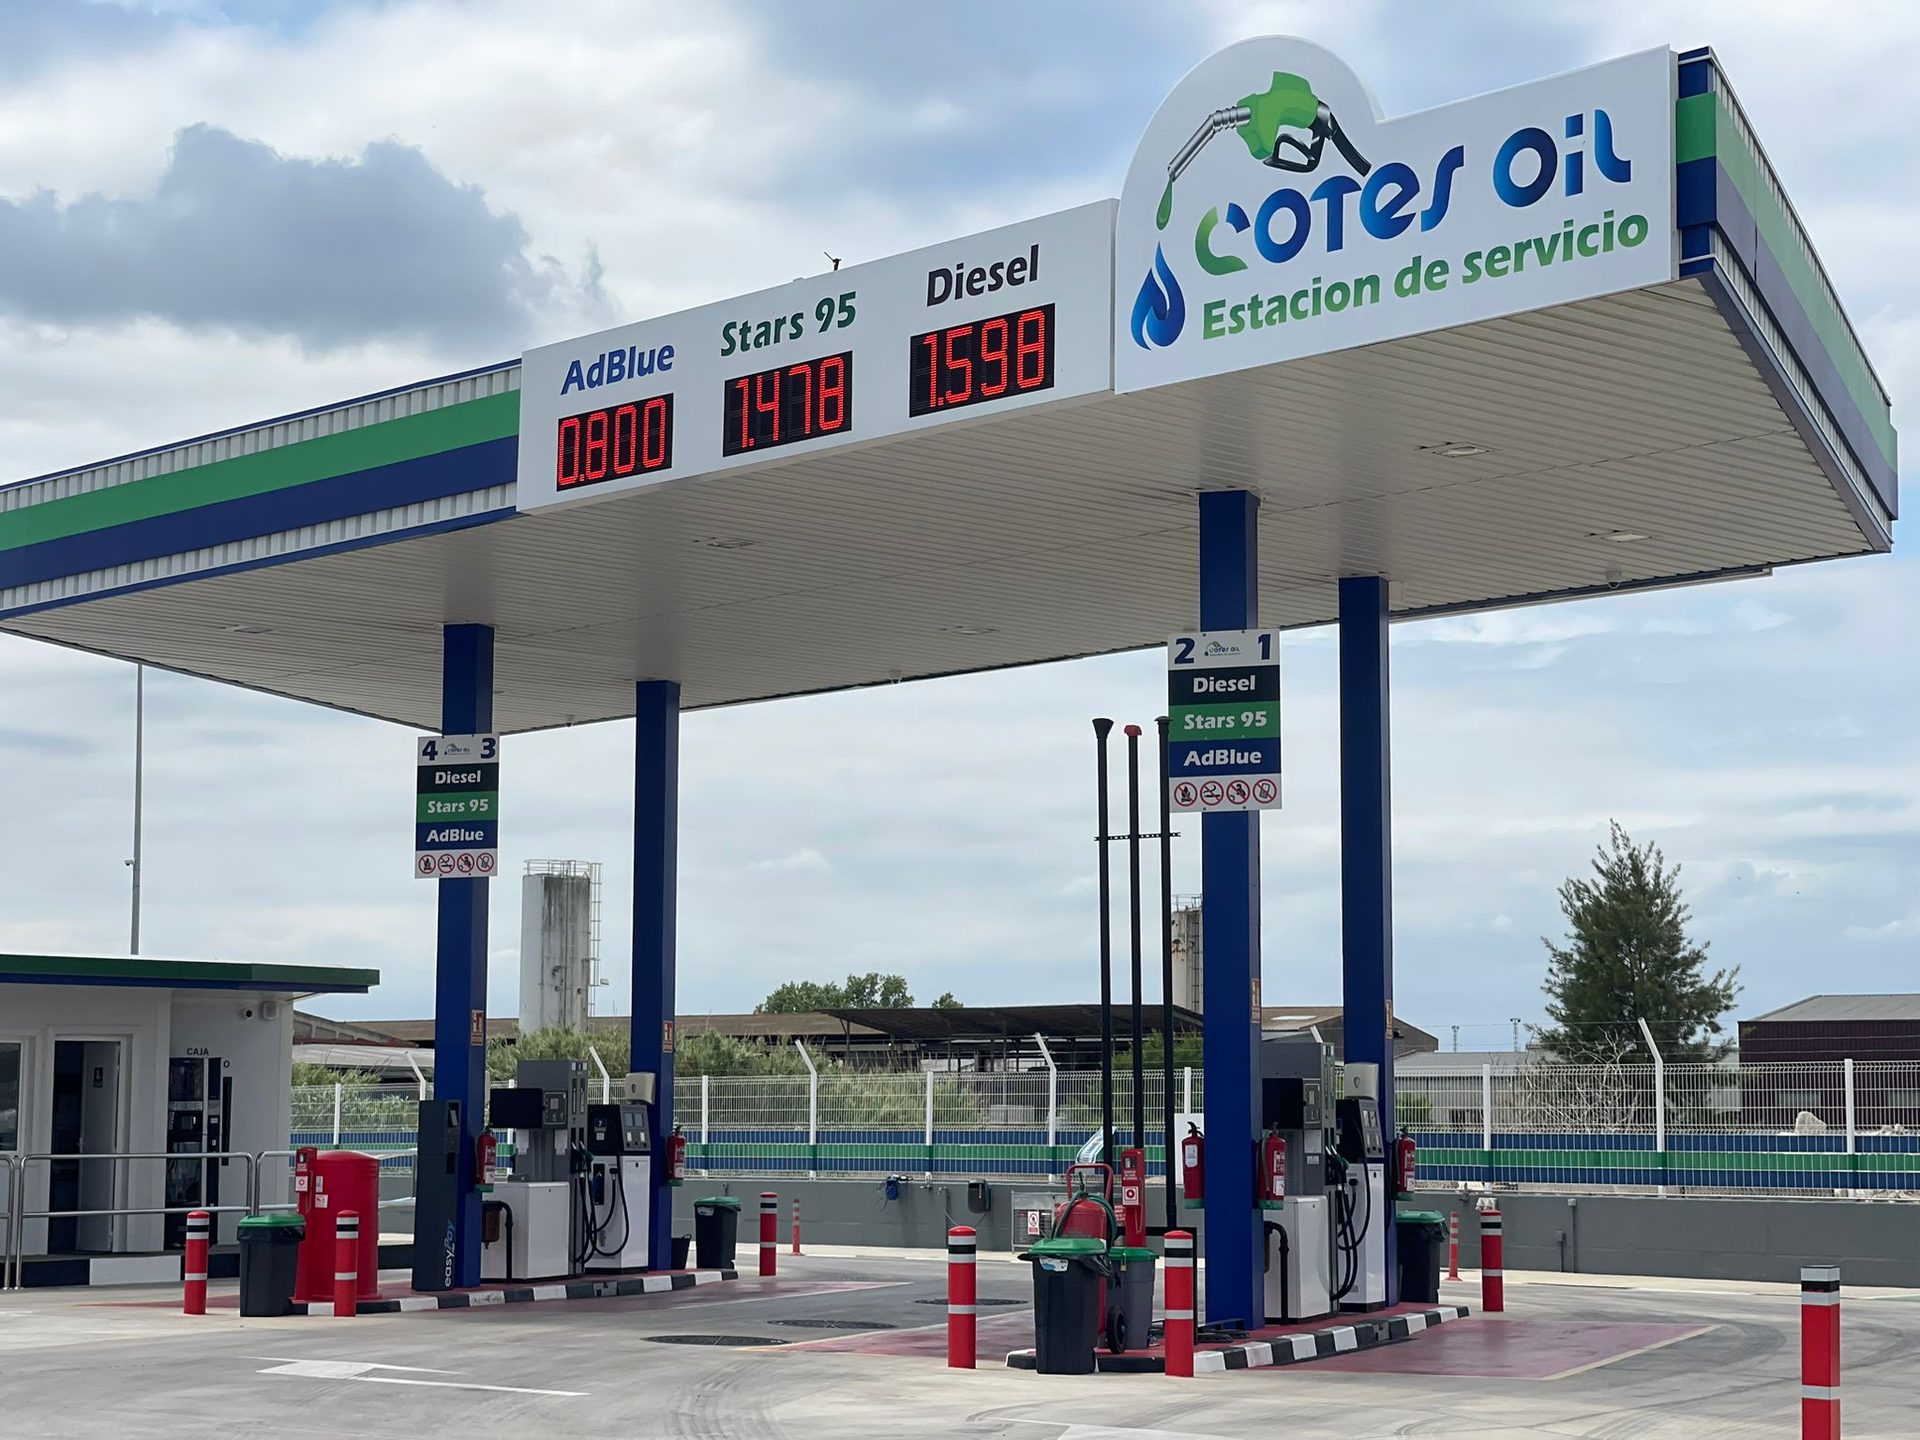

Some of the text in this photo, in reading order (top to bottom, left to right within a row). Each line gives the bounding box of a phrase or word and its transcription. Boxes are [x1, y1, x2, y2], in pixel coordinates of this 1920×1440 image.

[927, 244, 1040, 308] Diesel
[1203, 209, 1649, 340] Estacion de servicio
[720, 291, 857, 357] Stars 95
[560, 343, 675, 396] AdBlue
[922, 310, 1046, 408] 1.598
[735, 355, 846, 449] 1.478
[557, 397, 667, 486] 0.800
[1174, 637, 1196, 665] 2
[1258, 633, 1272, 661] 1
[1193, 674, 1256, 694] Diesel
[1184, 711, 1267, 730] Stars 95
[422, 740, 439, 761] 4
[480, 737, 497, 759] 3
[1183, 749, 1262, 767] AdBlue
[434, 770, 482, 785] Diesel
[427, 799, 489, 814] Stars 95
[426, 829, 484, 842] AdBlue
[186, 1047, 209, 1056] CAJA
